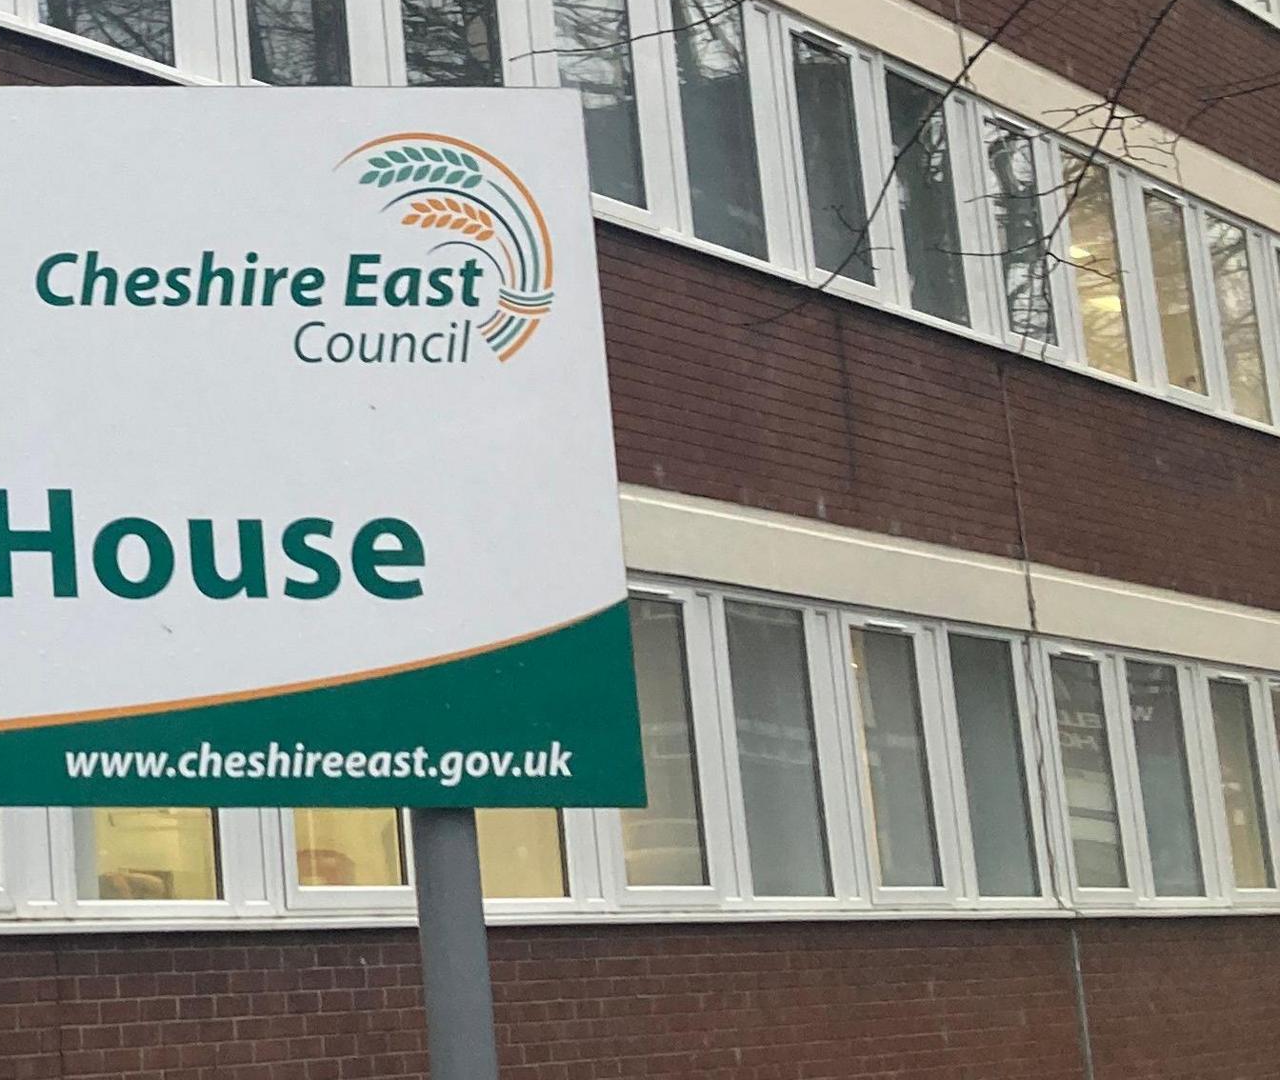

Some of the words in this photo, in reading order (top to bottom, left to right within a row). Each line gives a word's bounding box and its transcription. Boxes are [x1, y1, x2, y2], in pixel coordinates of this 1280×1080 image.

[35, 250, 326, 308] Cheshire
[344, 253, 484, 308] East
[293, 319, 471, 365] Council
[64, 741, 574, 788] www.cheshireeast.gov.uk
